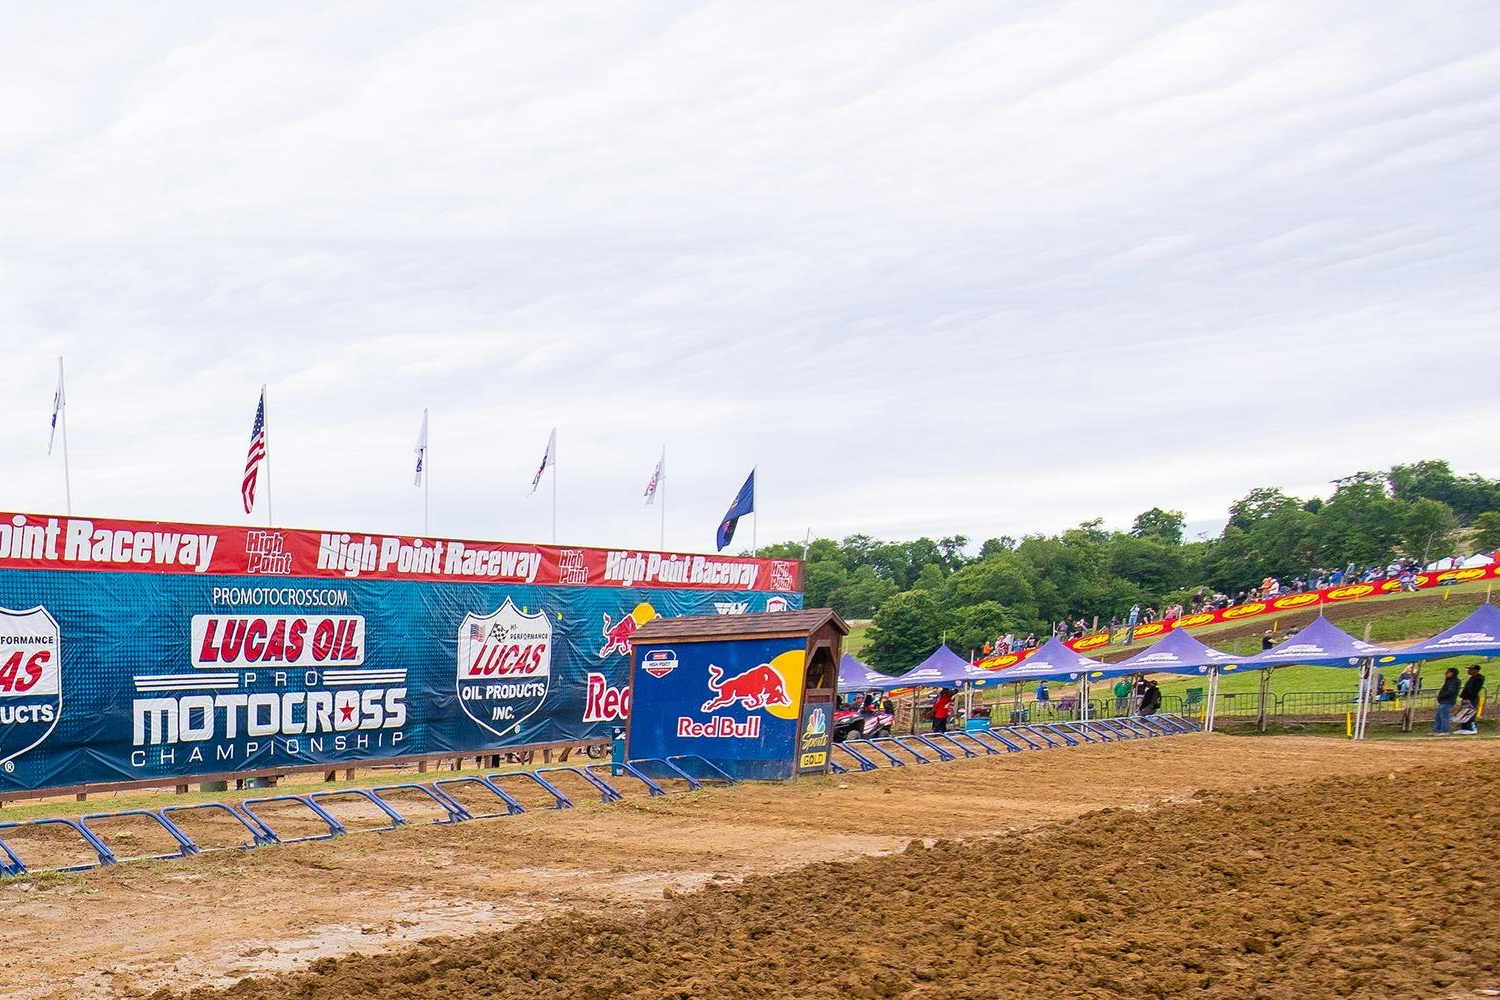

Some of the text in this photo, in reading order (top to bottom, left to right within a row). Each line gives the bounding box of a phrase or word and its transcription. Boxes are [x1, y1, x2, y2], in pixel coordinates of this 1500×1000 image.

[65, 519, 218, 573] Raceway
[246, 531, 284, 554] High
[247, 552, 293, 575] Point
[317, 533, 542, 584] High Point Raceway
[559, 549, 584, 568] High
[559, 566, 589, 584] Point
[604, 551, 759, 590] High Point Raceway
[213, 587, 348, 606] PROMOTOCROSS.COM
[199, 618, 360, 663] LUCAS OIL
[469, 643, 546, 676] LUCAS
[244, 671, 319, 688] PRO
[461, 683, 545, 701] OIL PRODUCTS
[132, 687, 408, 746] MOTOCROSS
[491, 705, 515, 721] INC.
[677, 716, 761, 738] Red Bull
[130, 731, 403, 767] CHAMPIONSHIP
[802, 732, 829, 751] Sports
[803, 753, 824, 766] GOLD
